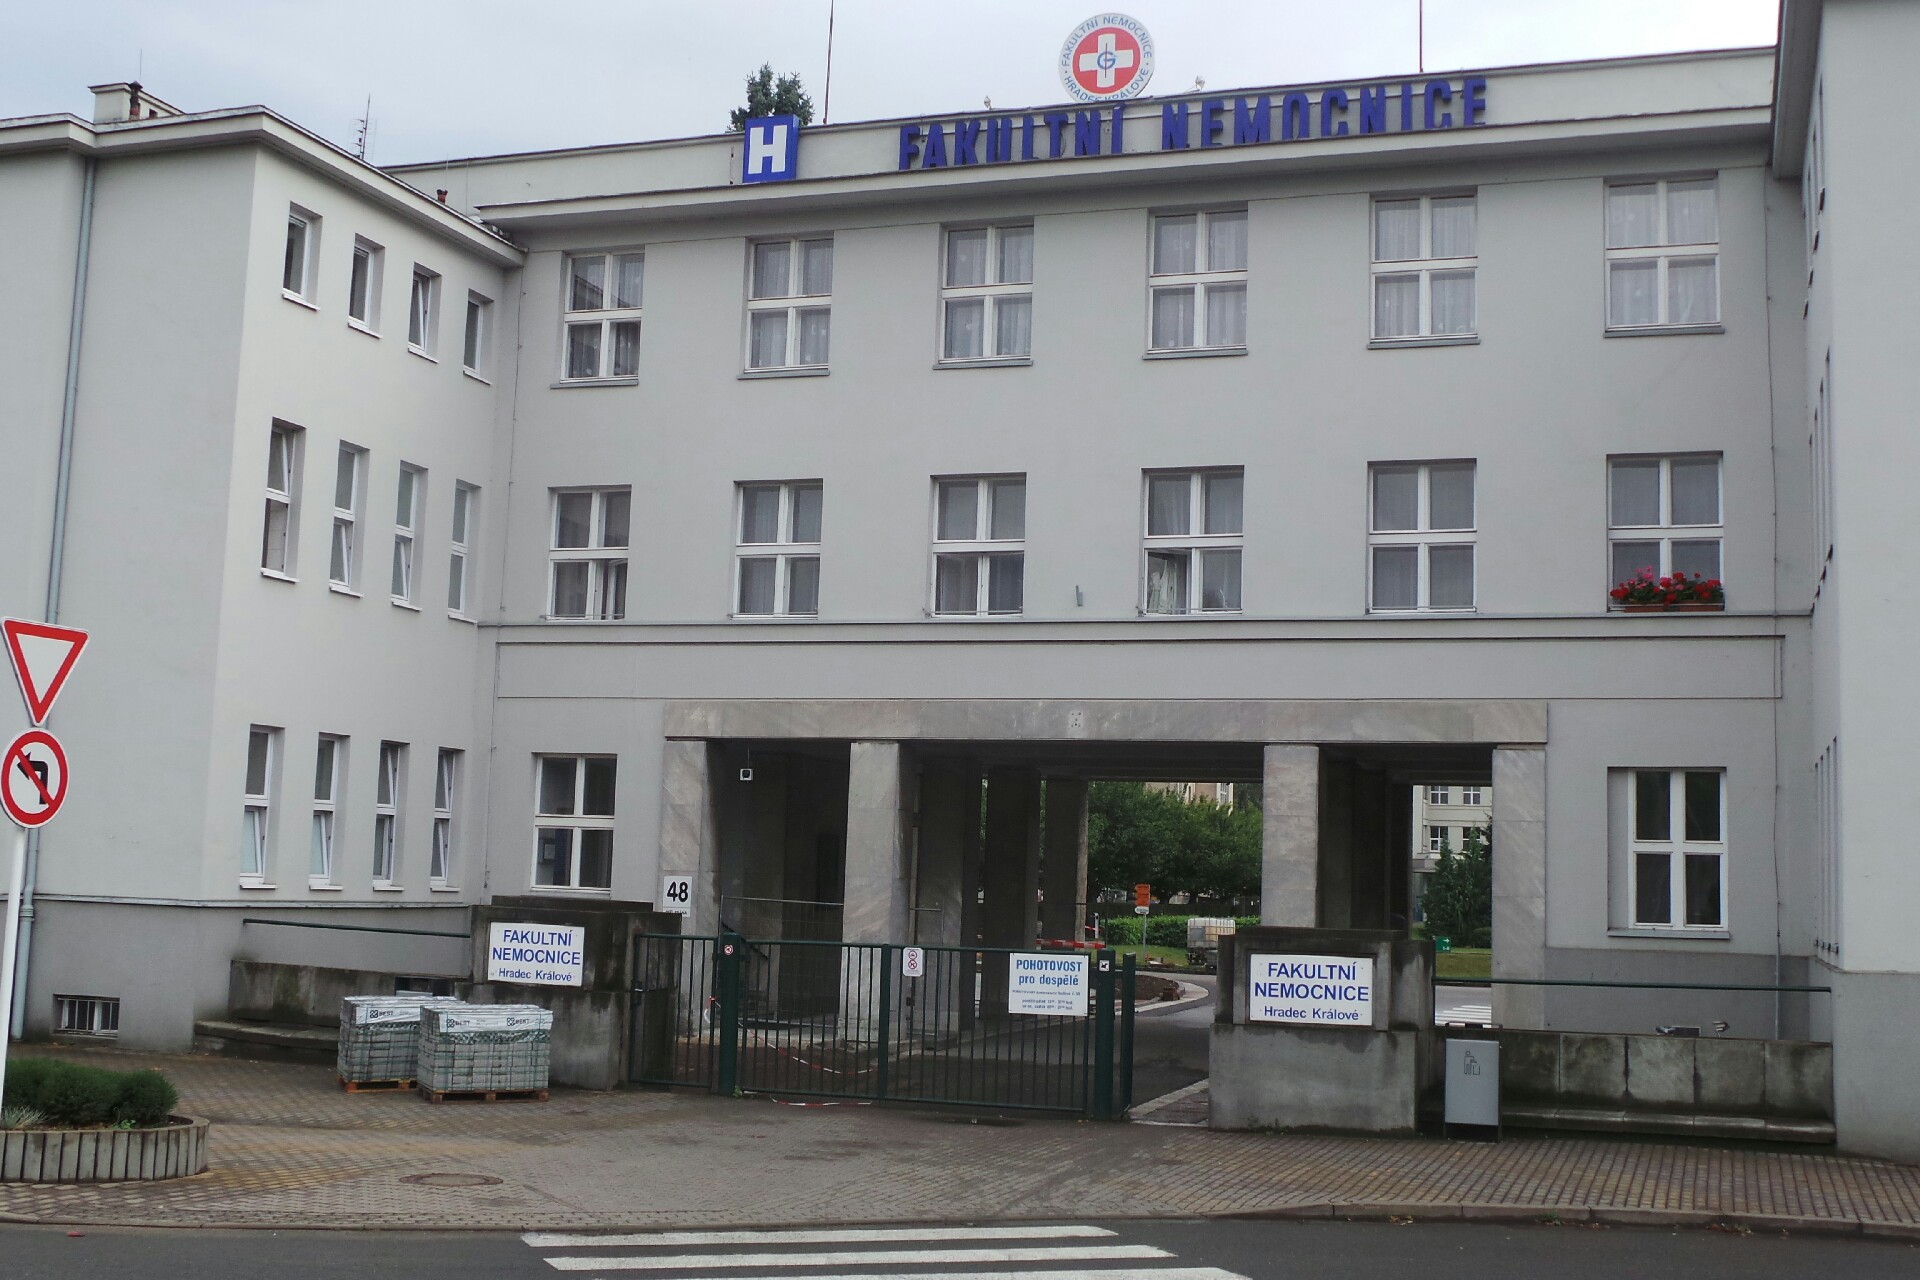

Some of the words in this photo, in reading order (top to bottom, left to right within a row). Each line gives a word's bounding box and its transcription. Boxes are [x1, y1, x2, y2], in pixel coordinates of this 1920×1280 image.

[1103, 15, 1153, 59] NEMOCNICE
[1161, 78, 1487, 150] NEMOCNICE
[747, 124, 788, 175] H
[666, 881, 689, 903] 48
[503, 929, 573, 946] FAKULTNÍ
[492, 947, 581, 965] NEMOCNICE
[498, 968, 532, 979] Hradec
[535, 970, 572, 981] Králové
[1016, 959, 1083, 972] POHOTOVOST
[1268, 961, 1357, 980] FAKULTNÍ
[1018, 975, 1035, 985] pro
[1039, 974, 1079, 987] dospělé
[1254, 982, 1369, 1001] NEMOCNICE
[1264, 1006, 1307, 1018] Hradec
[1312, 1008, 1359, 1020] Králové
